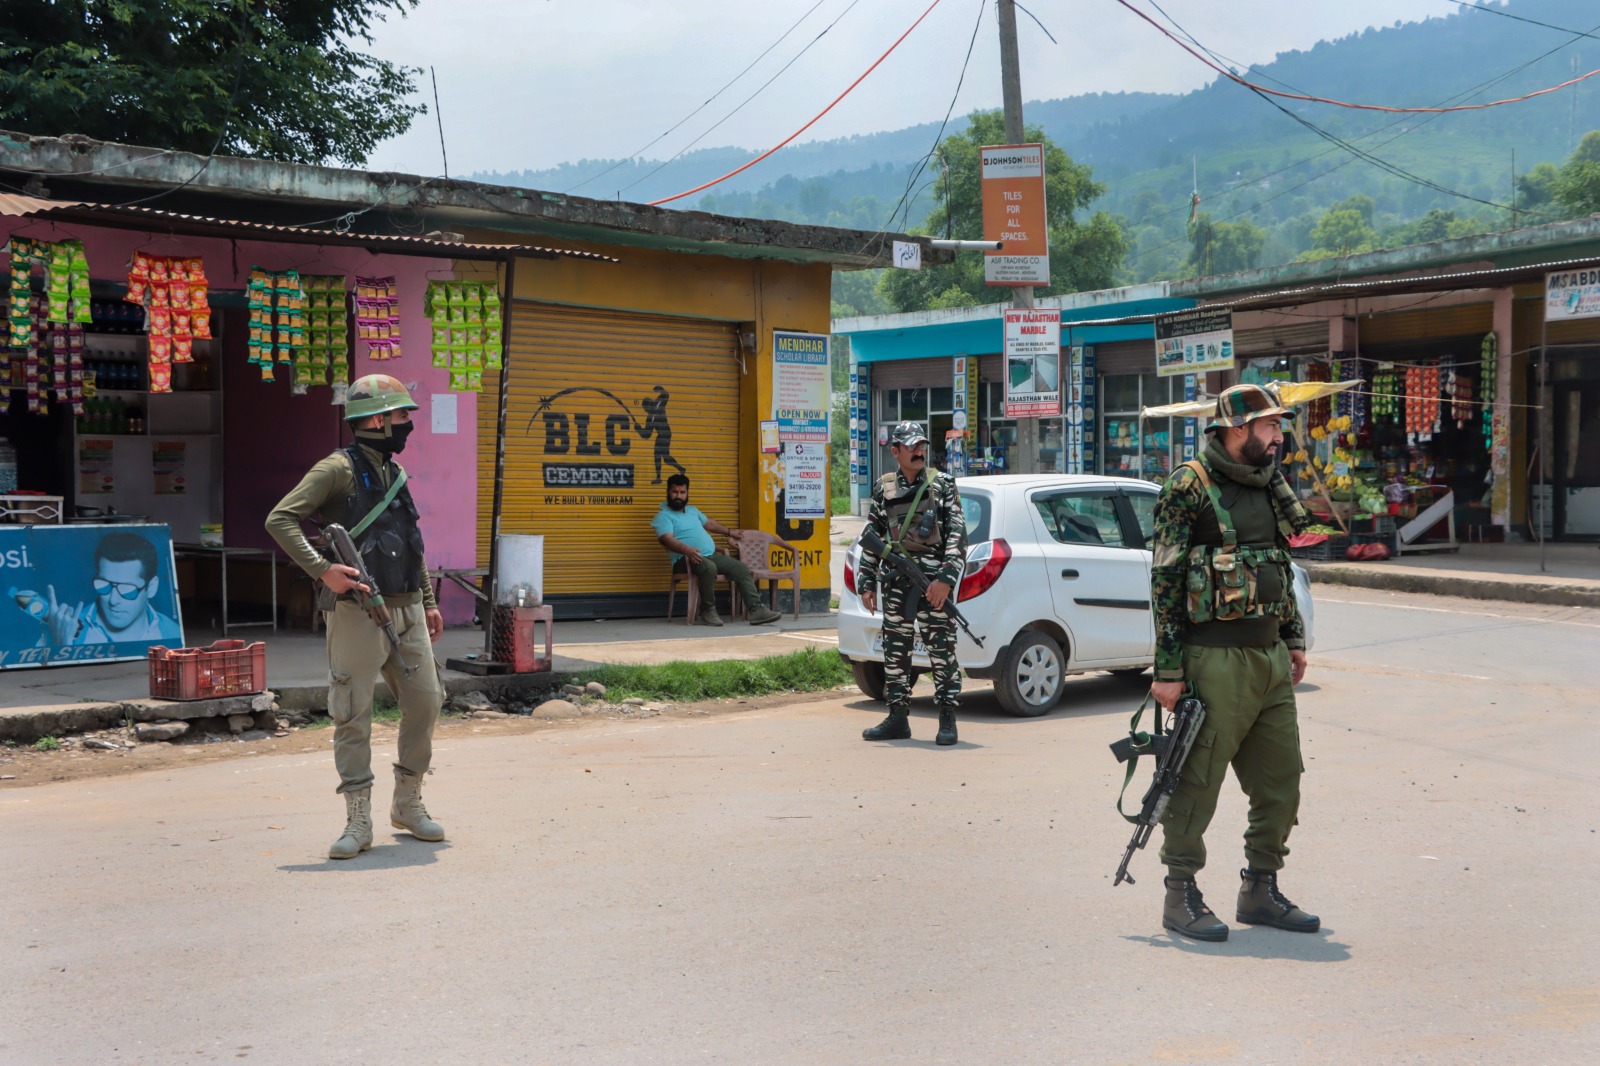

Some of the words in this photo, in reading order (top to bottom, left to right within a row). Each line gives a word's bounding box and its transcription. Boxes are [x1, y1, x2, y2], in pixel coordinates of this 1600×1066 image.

[989, 156, 1023, 165] JOHNSON
[1023, 155, 1040, 164] TILES
[1003, 191, 1023, 201] TILES
[1006, 205, 1021, 214] FOR
[1007, 219, 1021, 228] ALL
[1000, 232, 1029, 241] SPACES.
[991, 256, 1002, 264] ASIF
[1003, 256, 1029, 264] TRADING
[1006, 314, 1021, 323] NEW
[1023, 313, 1059, 323] RAJASTHAN
[1020, 326, 1047, 335] MARBLE
[779, 338, 823, 352] MENDHAR
[776, 351, 802, 363] SCHOLAR
[803, 354, 826, 364] LIBRARY
[1042, 394, 1059, 402] WALE
[781, 409, 801, 418] OPEN
[803, 410, 821, 419] NOW
[543, 412, 631, 455] BLC
[546, 467, 630, 485] CEMENT
[544, 495, 561, 506] WE
